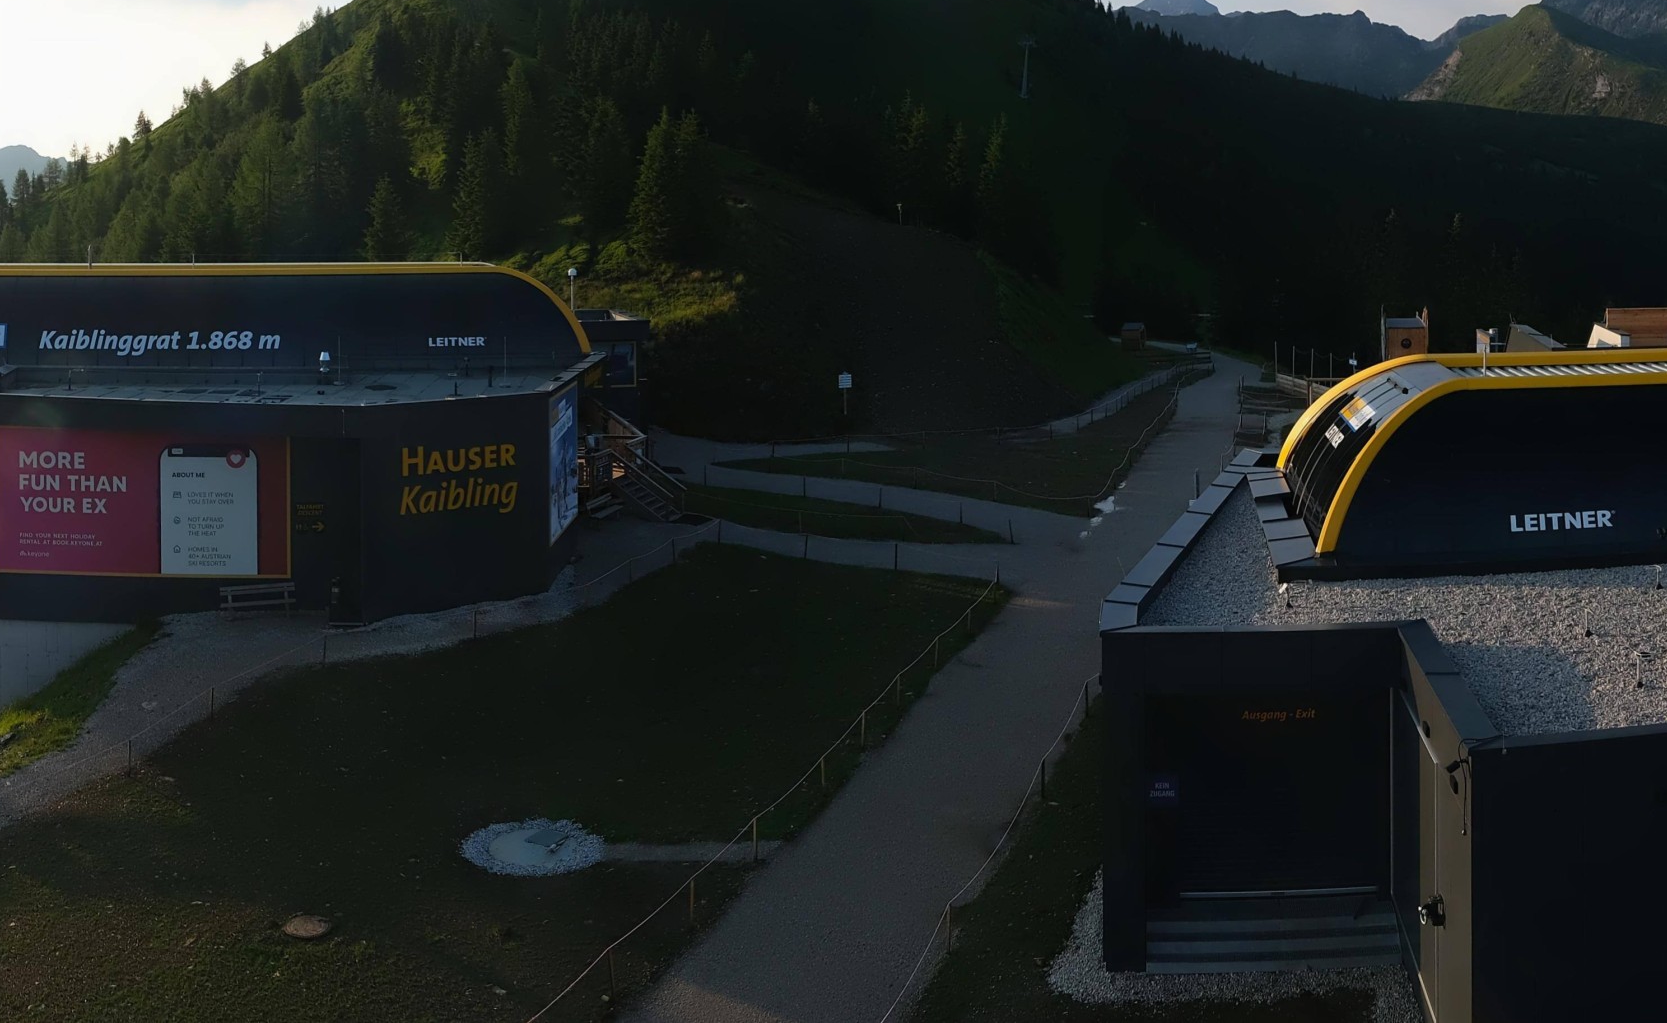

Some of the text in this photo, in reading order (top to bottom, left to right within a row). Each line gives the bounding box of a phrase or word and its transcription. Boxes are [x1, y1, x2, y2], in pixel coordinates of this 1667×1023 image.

[39, 330, 281, 356] Kaiblinggrat 1.868 m
[428, 336, 487, 348] LEITNER
[18, 451, 85, 469] MORE
[402, 443, 516, 476] HAUSER
[19, 474, 127, 492] FUN THAN
[20, 496, 107, 514] YOUR EX
[400, 477, 518, 515] Kaibling
[1509, 509, 1614, 532] LEITNER
[1241, 710, 1287, 722] Ausgang
[1295, 708, 1316, 719] Exit
